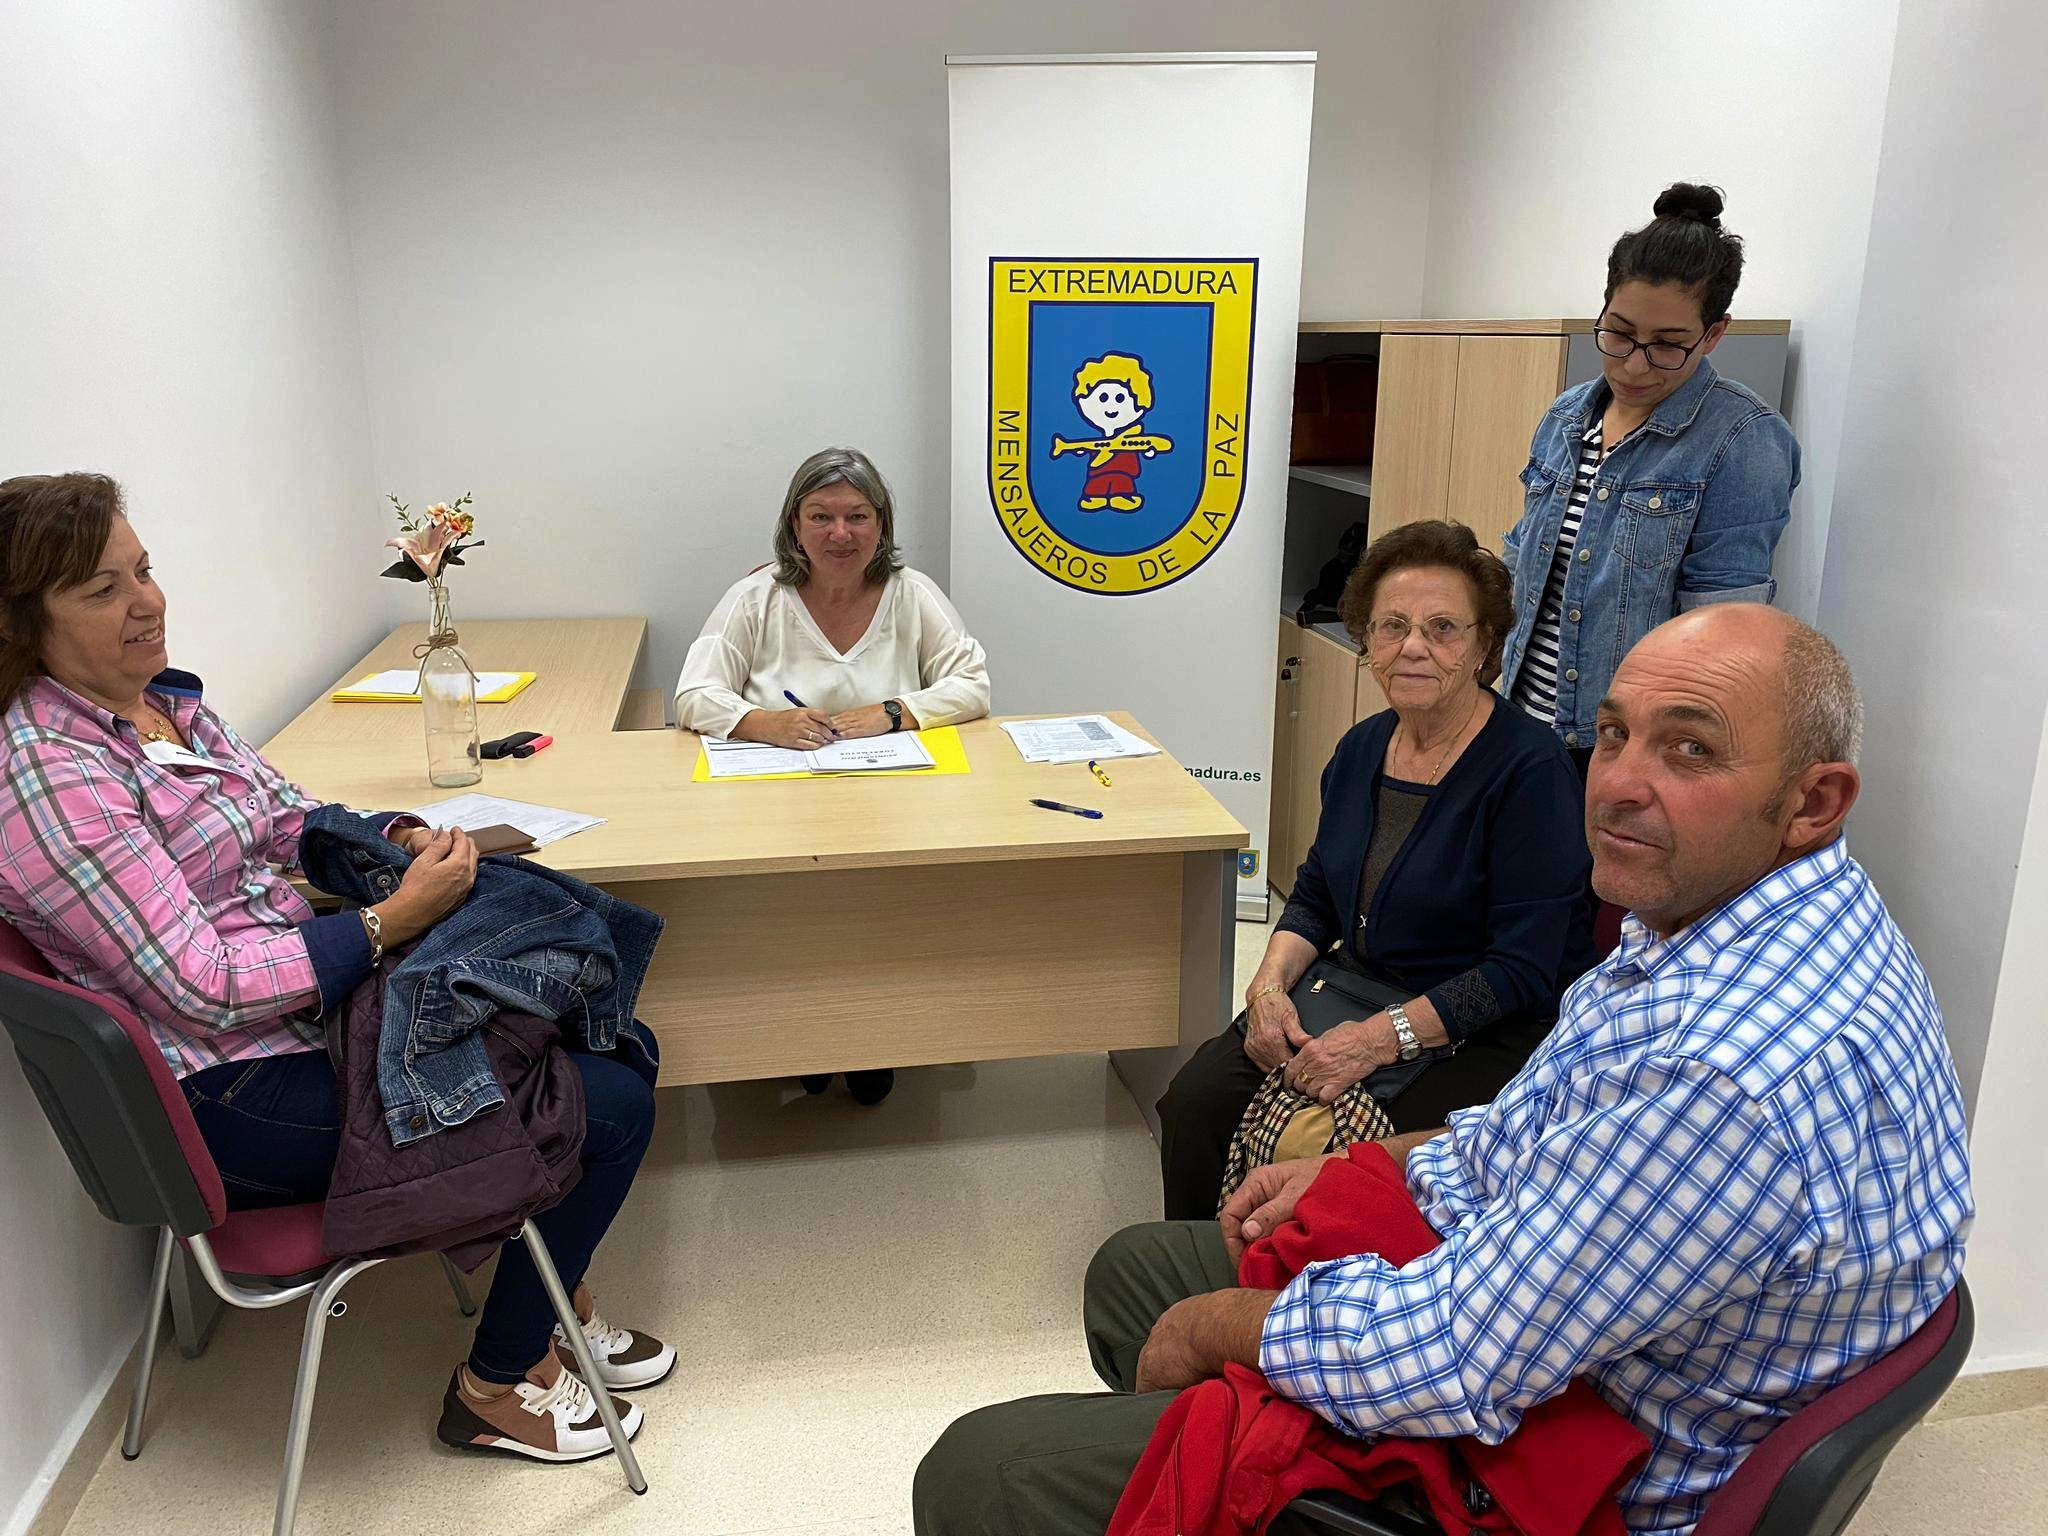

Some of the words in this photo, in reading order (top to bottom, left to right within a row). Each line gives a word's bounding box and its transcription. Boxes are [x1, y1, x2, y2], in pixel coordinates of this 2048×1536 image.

[1008, 268, 1238, 295] EXTREMADURA
[997, 409, 1109, 585] MENSAJEROS
[1137, 548, 1182, 583] DE
[1190, 509, 1227, 546] LA
[1213, 412, 1240, 478] PAZ
